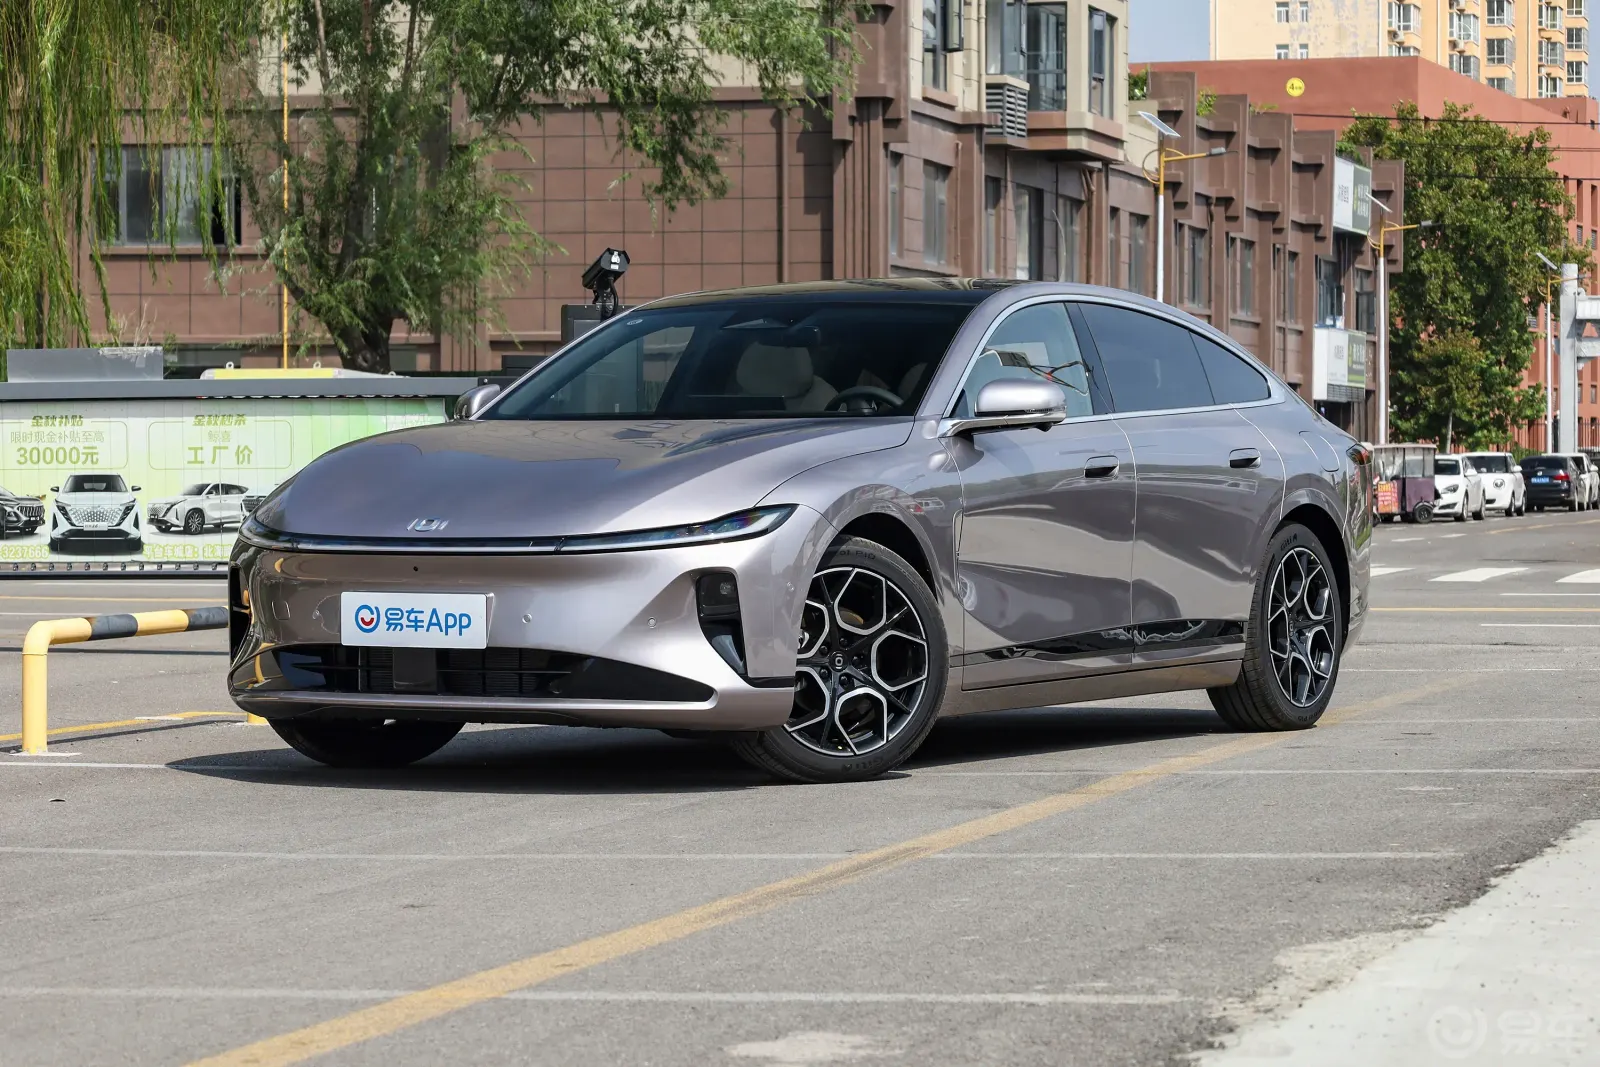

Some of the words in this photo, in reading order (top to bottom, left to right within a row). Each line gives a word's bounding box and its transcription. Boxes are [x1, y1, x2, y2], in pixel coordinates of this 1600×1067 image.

[31, 414, 84, 427] 金秋补贴
[192, 413, 247, 427] 金秋秒杀
[10, 430, 105, 443] 限时现金补贴至高
[16, 445, 99, 465] 30000元
[187, 445, 253, 465] 工厂价
[384, 607, 472, 636] 易车App
